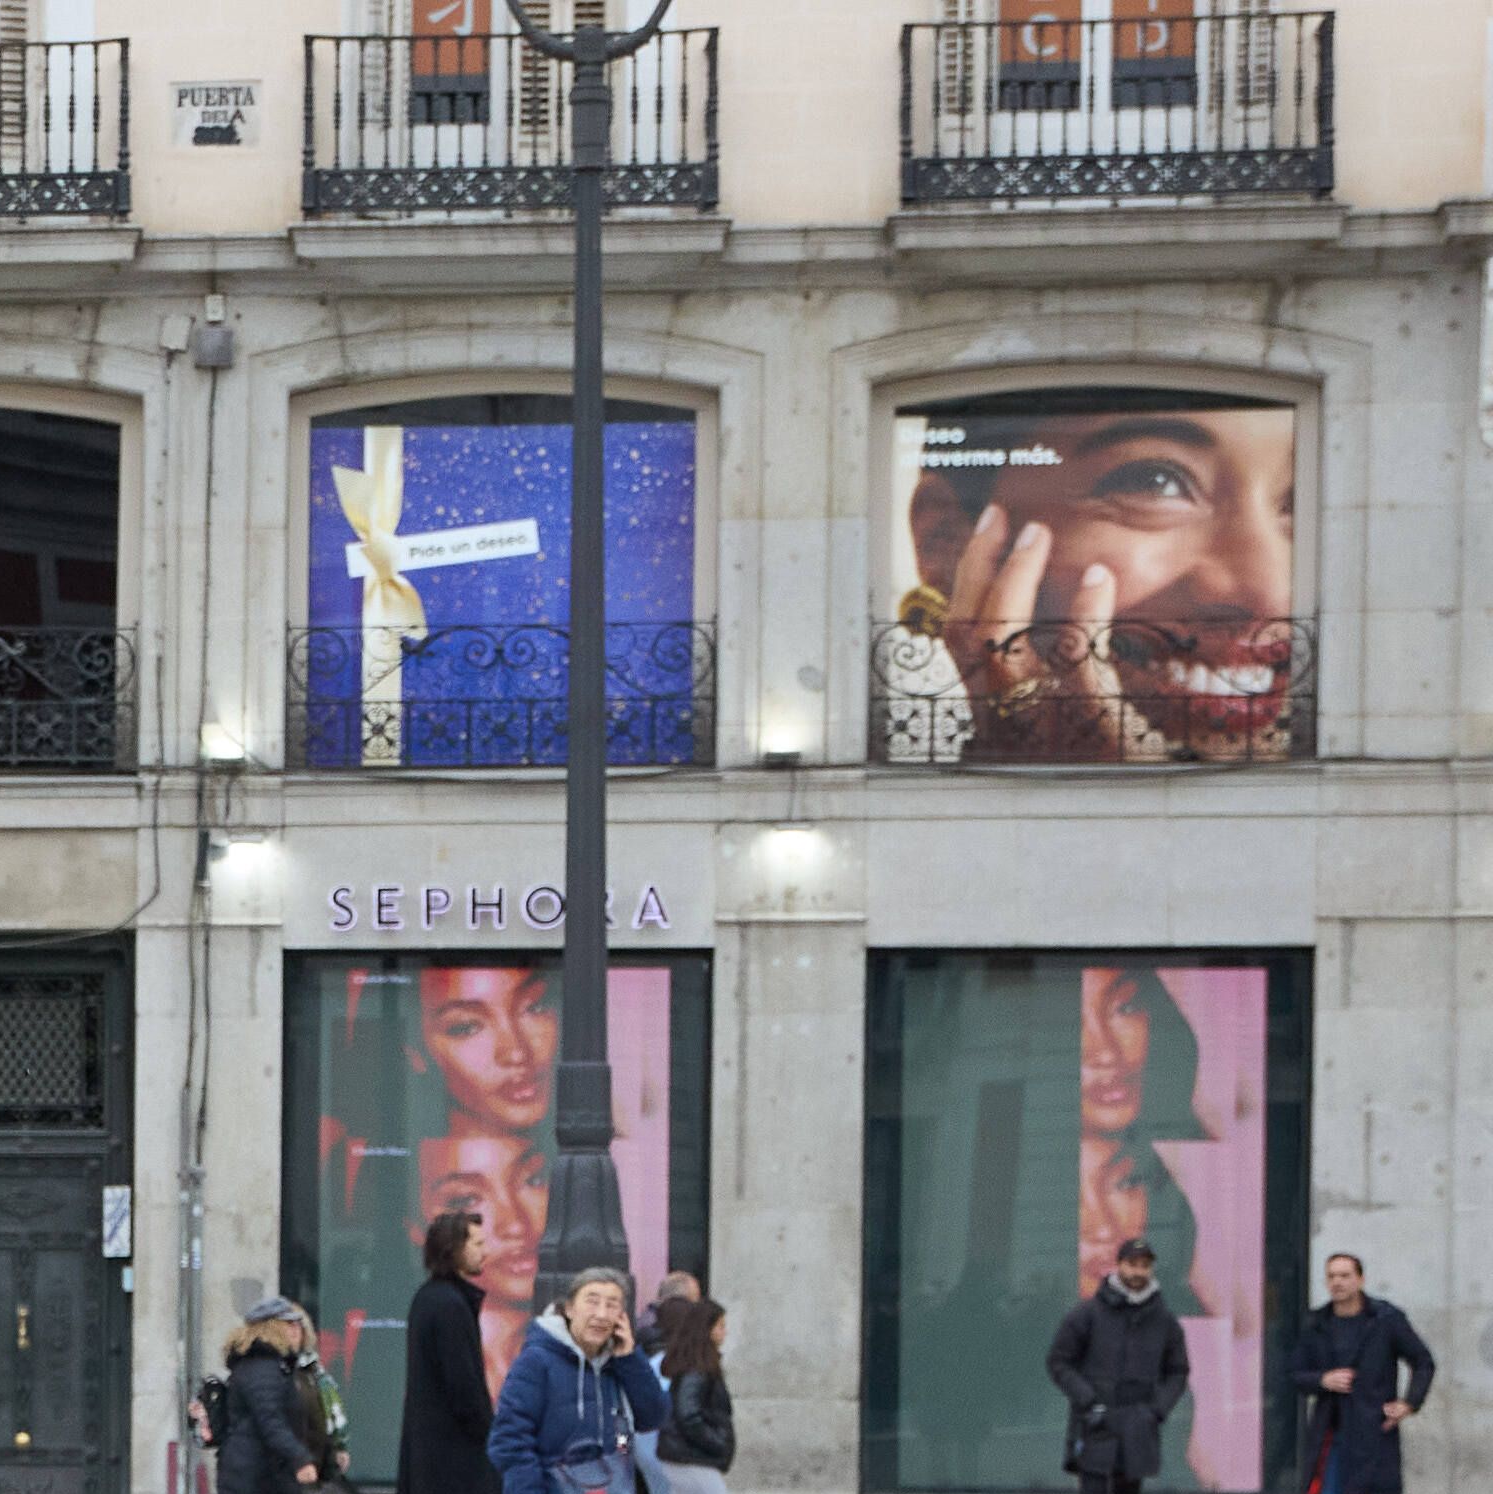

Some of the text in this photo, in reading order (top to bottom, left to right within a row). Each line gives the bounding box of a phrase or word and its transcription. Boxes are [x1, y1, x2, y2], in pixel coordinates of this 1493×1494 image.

[177, 87, 256, 107] PUERTA
[409, 534, 528, 560] Pide un deseo
[331, 885, 671, 928] SEPHOA
